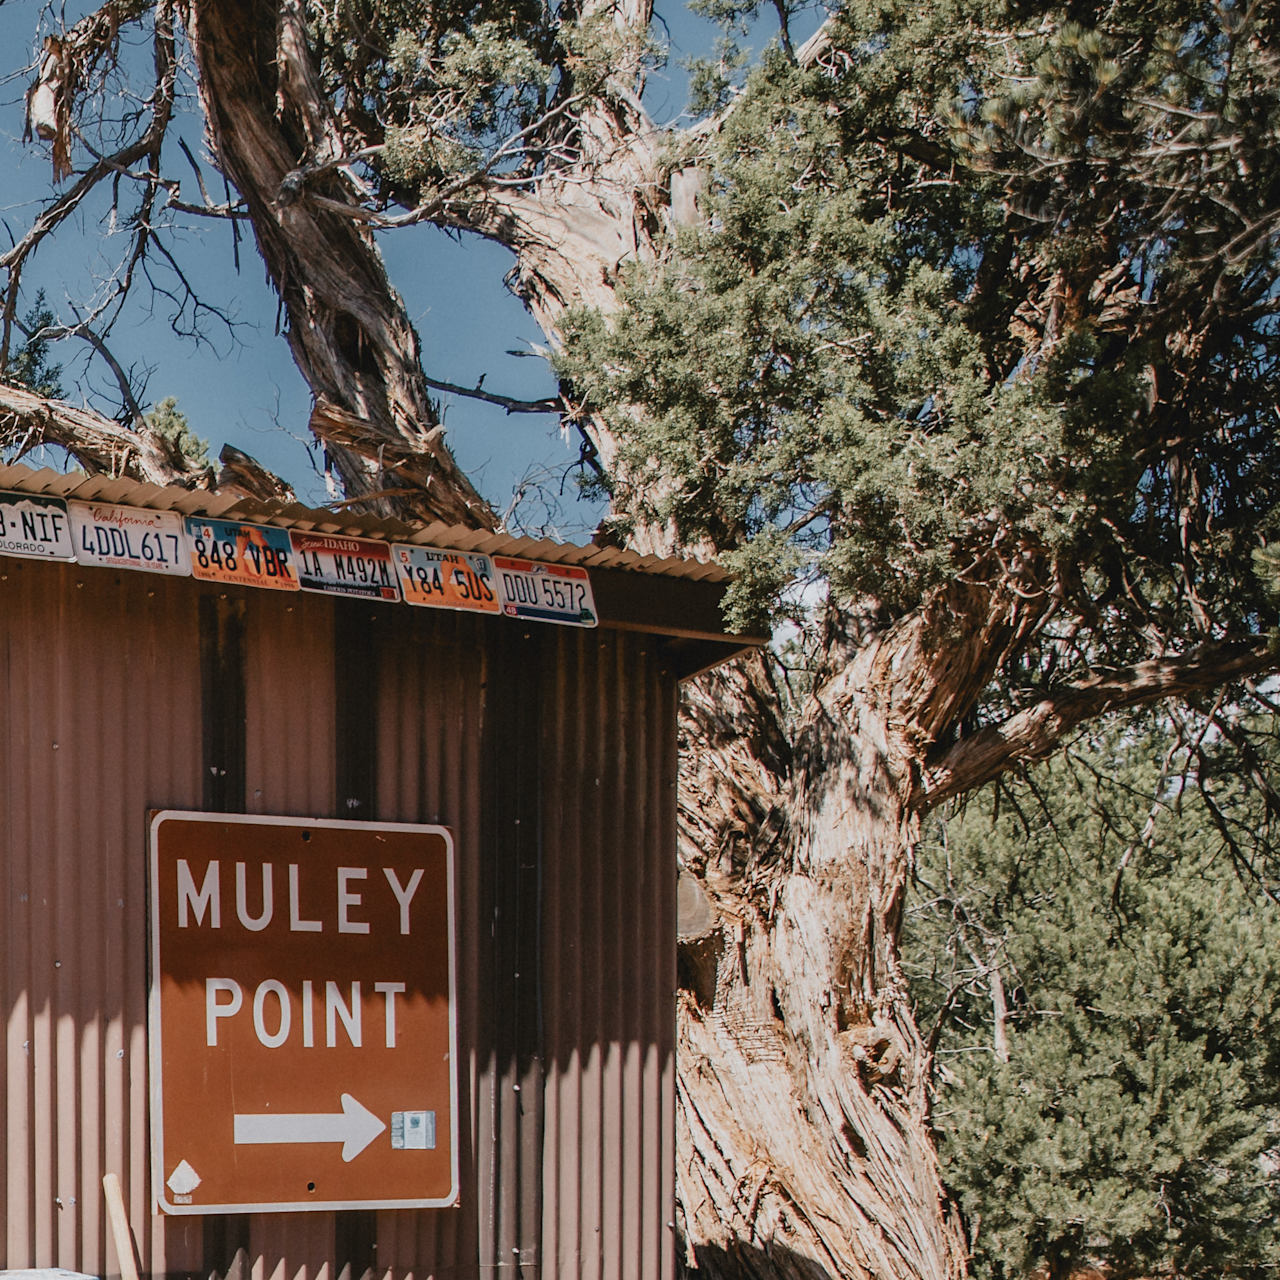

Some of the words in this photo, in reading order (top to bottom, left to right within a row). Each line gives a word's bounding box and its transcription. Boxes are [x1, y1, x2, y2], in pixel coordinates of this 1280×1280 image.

[94, 508, 162, 528] California
[224, 528, 250, 537] UTAH
[83, 525, 178, 564] 4DDL617
[195, 539, 237, 571] 848
[249, 544, 291, 578] VBR
[324, 538, 360, 552] IDAHO
[401, 552, 408, 562] 5
[425, 552, 459, 563] UTAH
[300, 550, 323, 577] 1A
[334, 553, 390, 587] M492M
[403, 565, 444, 595] Y84
[454, 570, 493, 601] 5US
[503, 573, 537, 604] DDU
[542, 579, 589, 610] 5572
[176, 858, 425, 935] MULEY
[206, 977, 406, 1048] POINT
